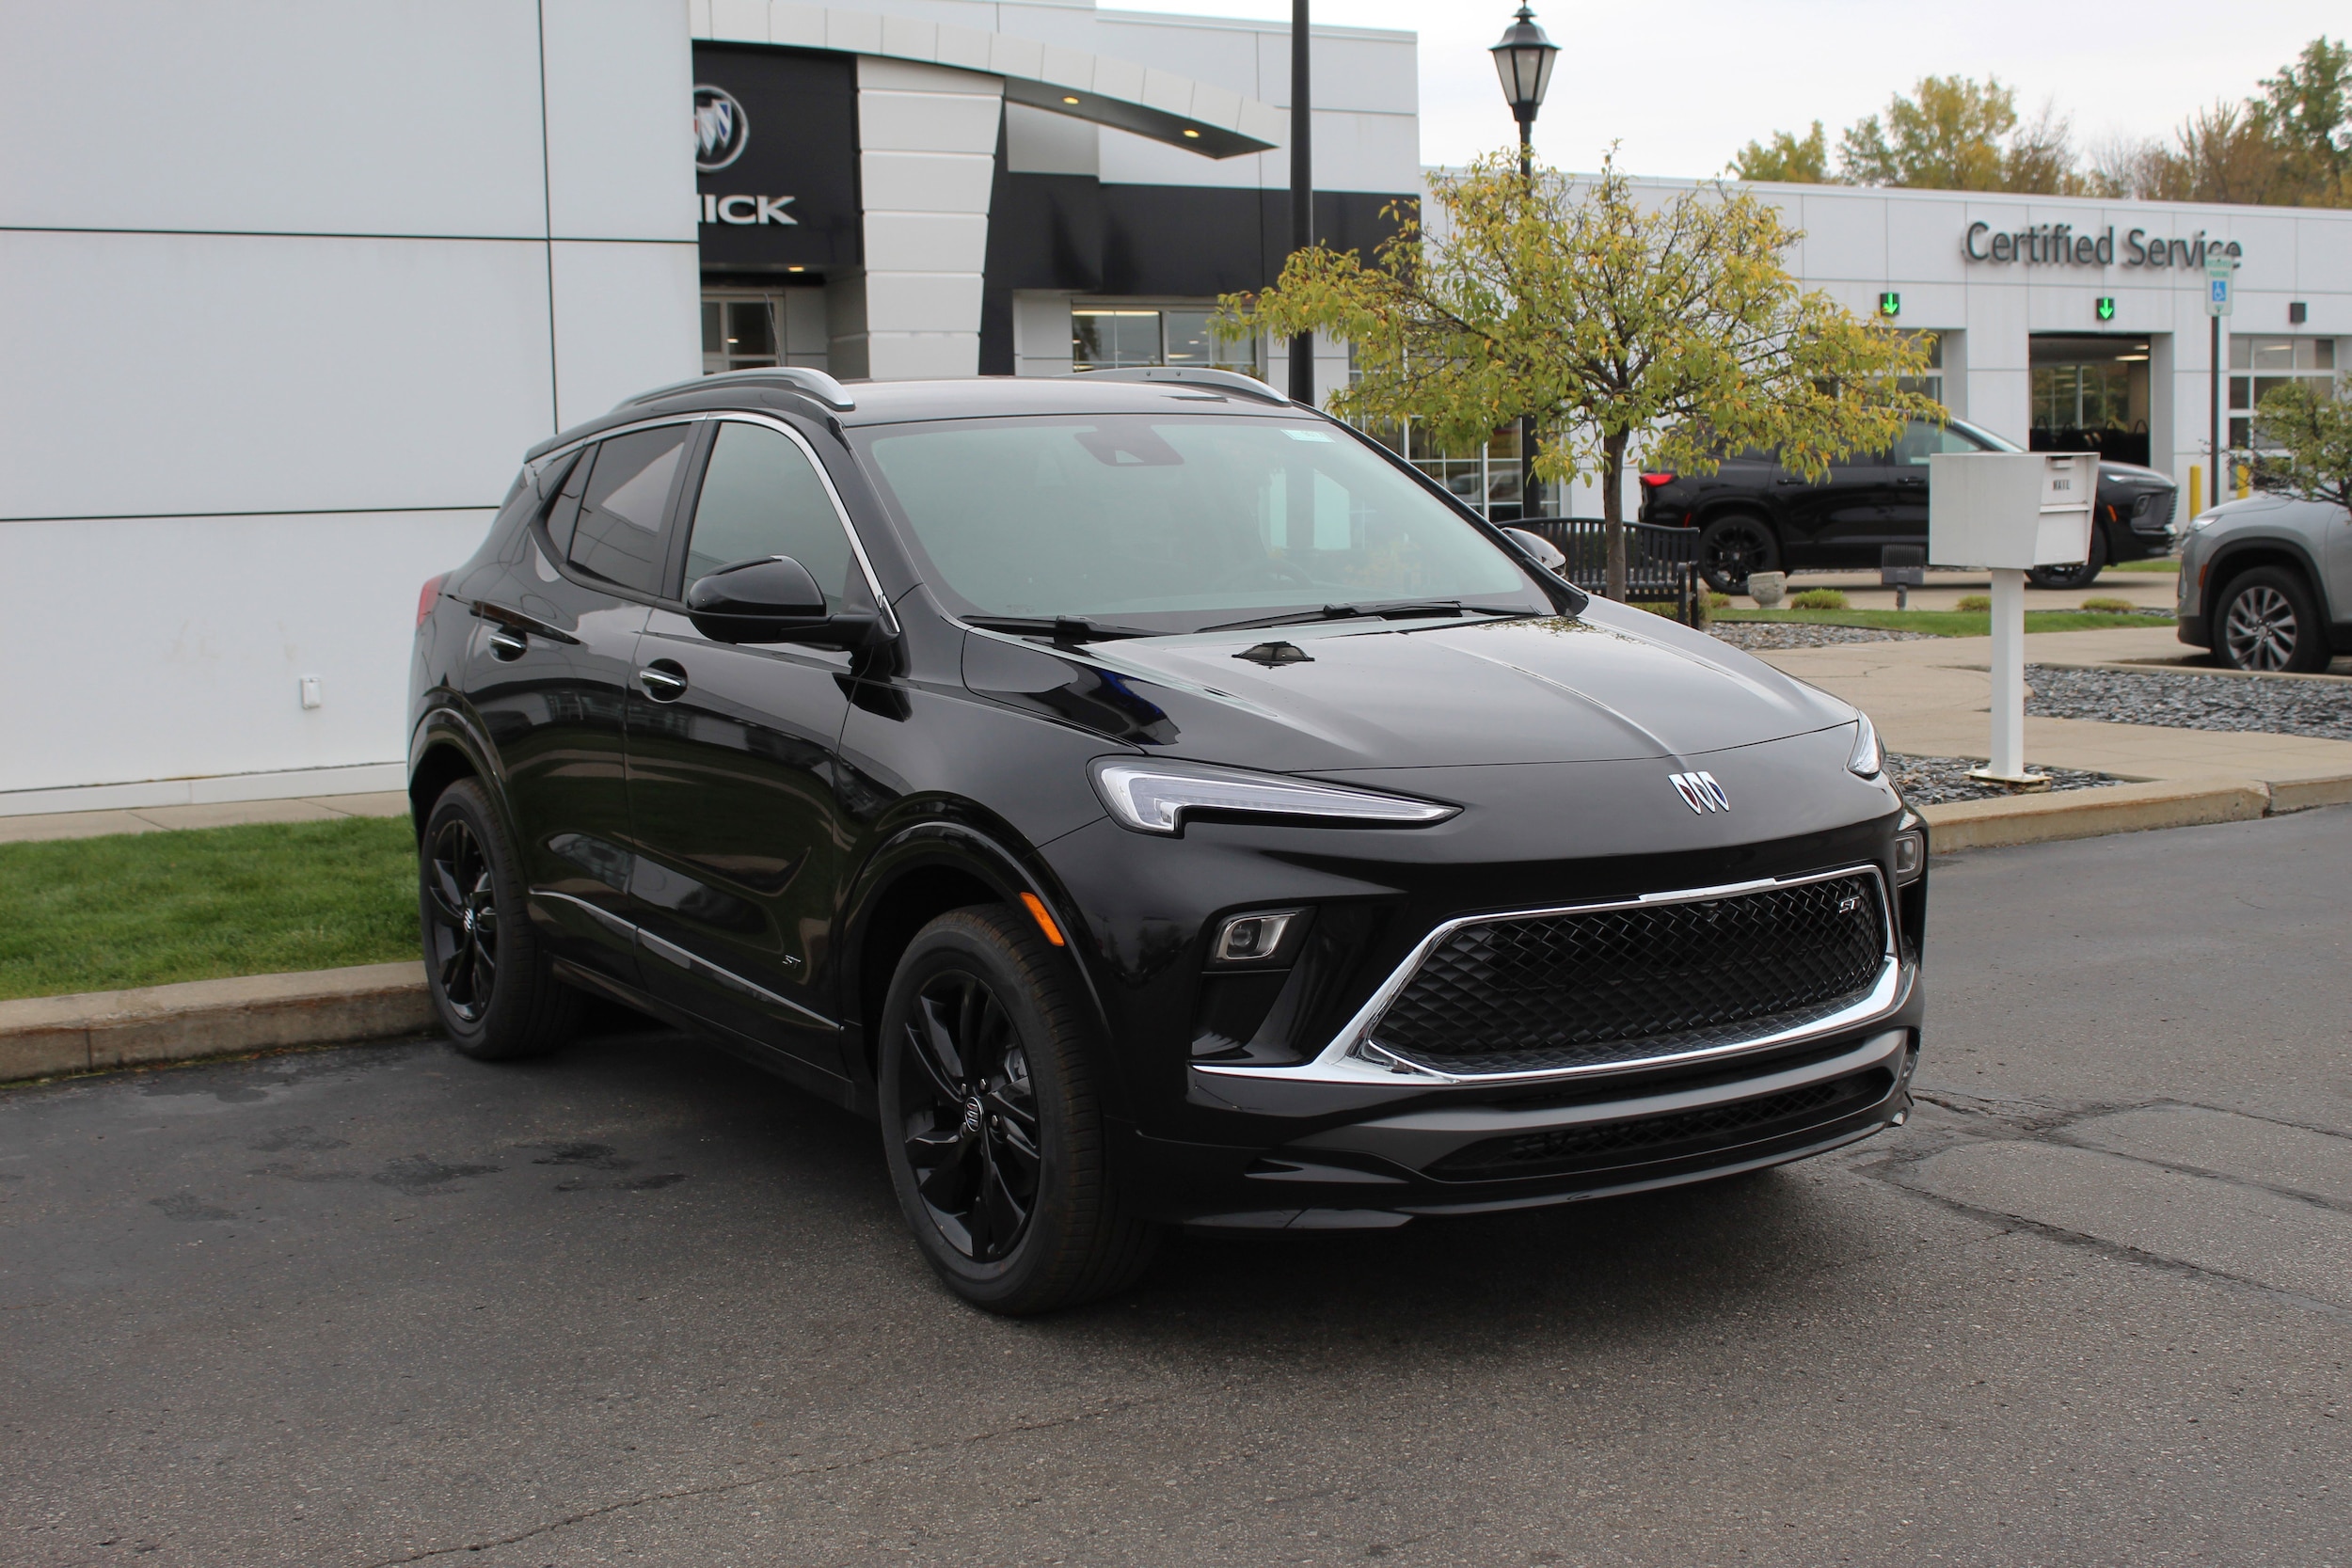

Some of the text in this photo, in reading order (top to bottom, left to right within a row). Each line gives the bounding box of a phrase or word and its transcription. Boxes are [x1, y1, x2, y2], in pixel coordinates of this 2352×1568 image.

[696, 194, 799, 226] ICK
[1964, 221, 2114, 265] Certified
[2053, 479, 2071, 490] MAIL
[1838, 895, 1861, 913] ST
[782, 954, 802, 970] ST
